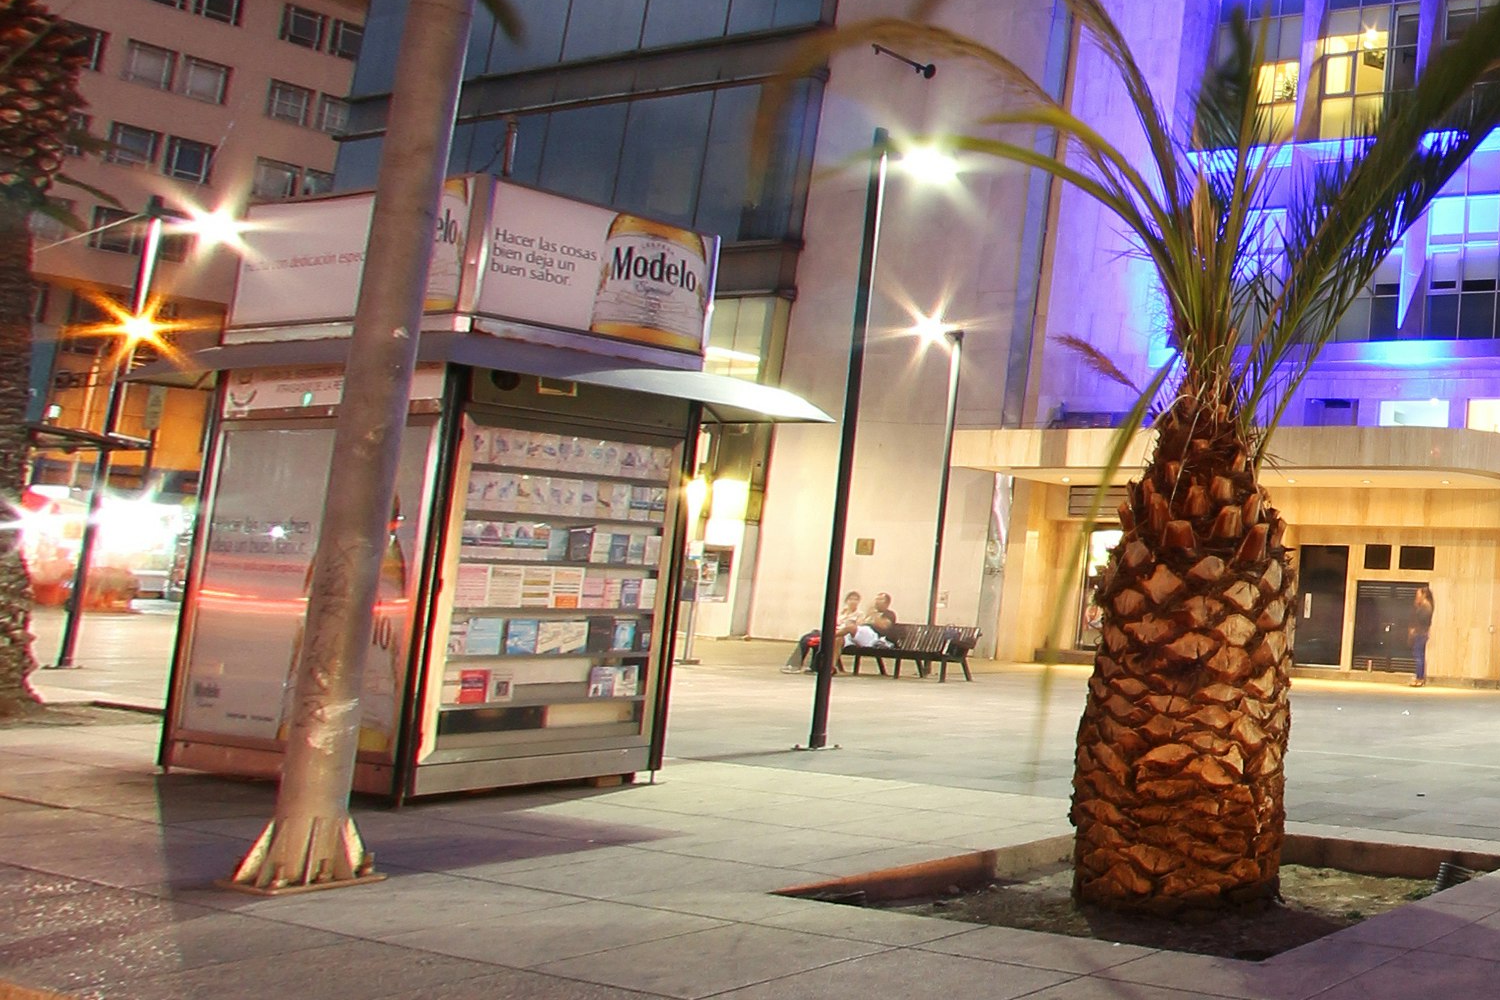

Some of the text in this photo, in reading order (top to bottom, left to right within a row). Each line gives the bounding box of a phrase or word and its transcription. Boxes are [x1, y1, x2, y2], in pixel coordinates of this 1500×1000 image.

[435, 208, 458, 244] elo
[492, 243, 576, 272] bien deja un
[494, 227, 597, 261] Hacer las cosas
[490, 258, 572, 287] buen sabor.
[610, 246, 697, 292] Modelo
